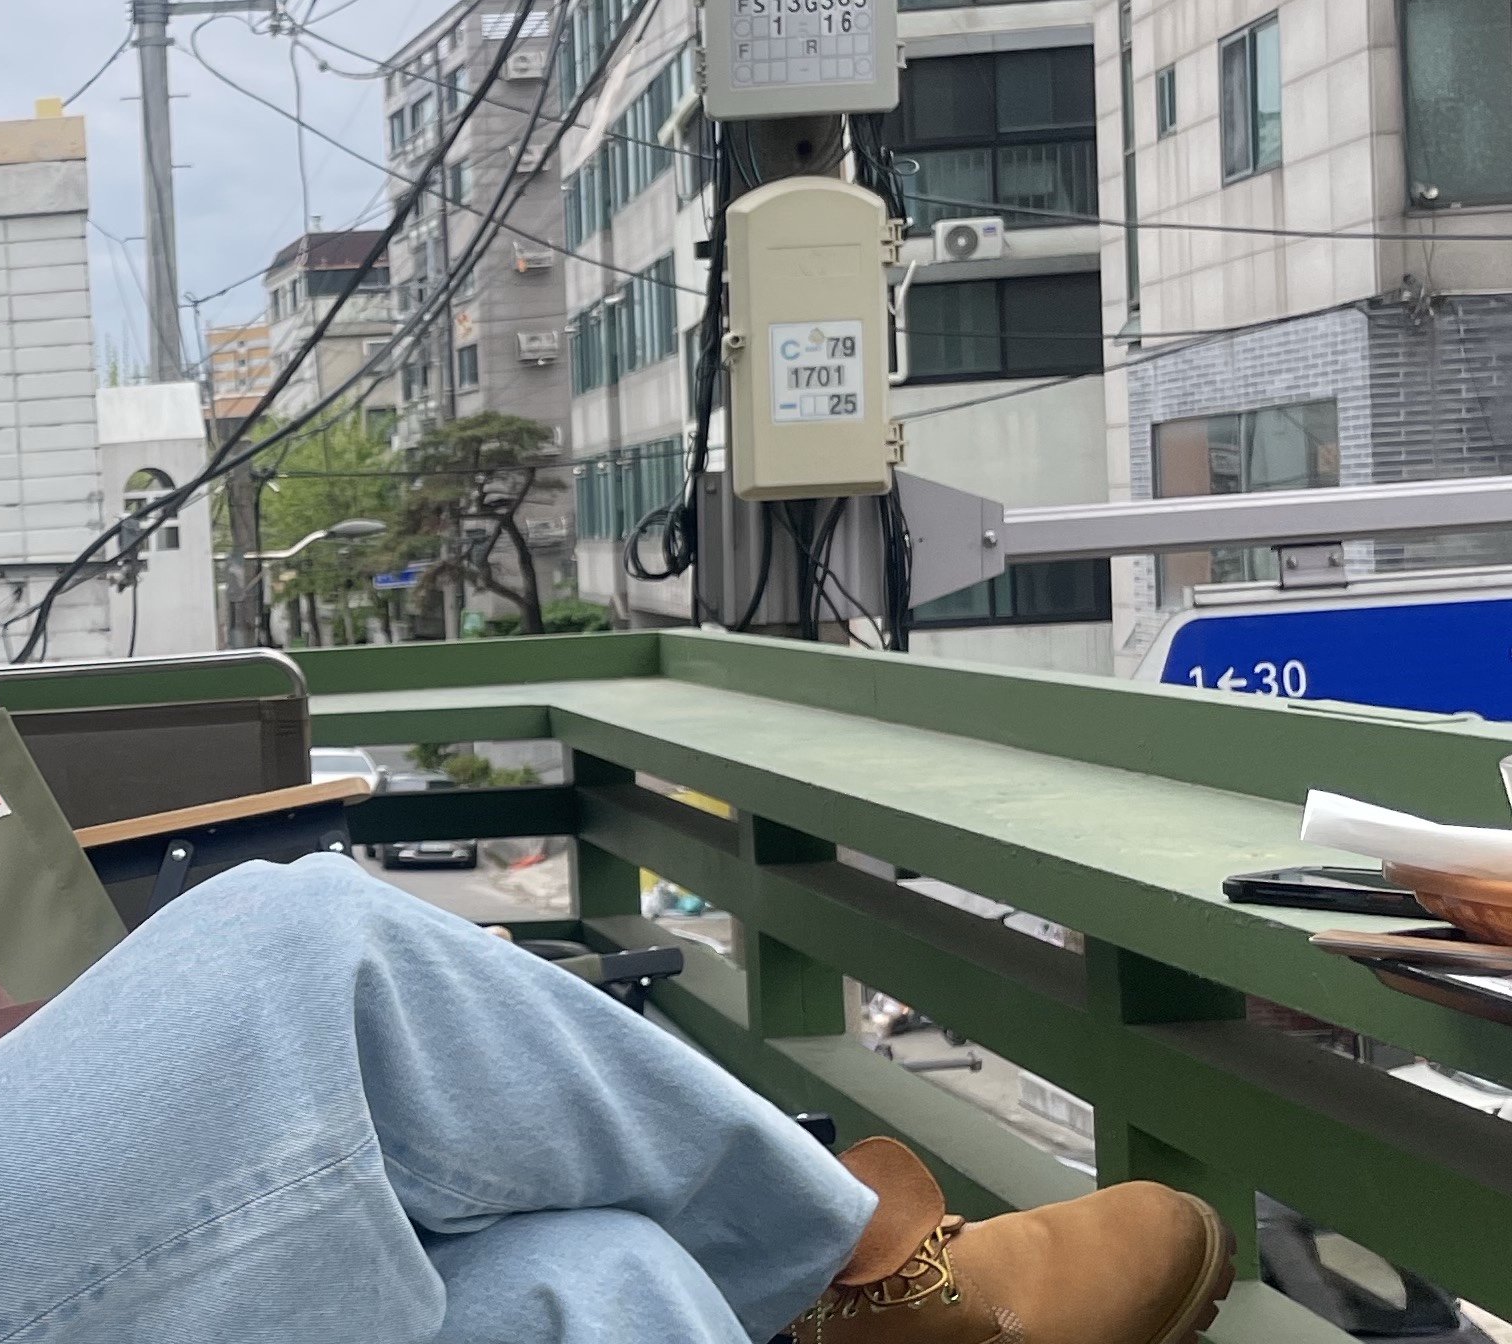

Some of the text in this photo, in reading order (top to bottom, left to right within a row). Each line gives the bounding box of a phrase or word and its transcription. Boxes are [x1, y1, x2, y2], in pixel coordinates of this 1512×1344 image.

[780, 336, 856, 360] C 79
[791, 364, 842, 388] 1701
[829, 393, 857, 415] 25
